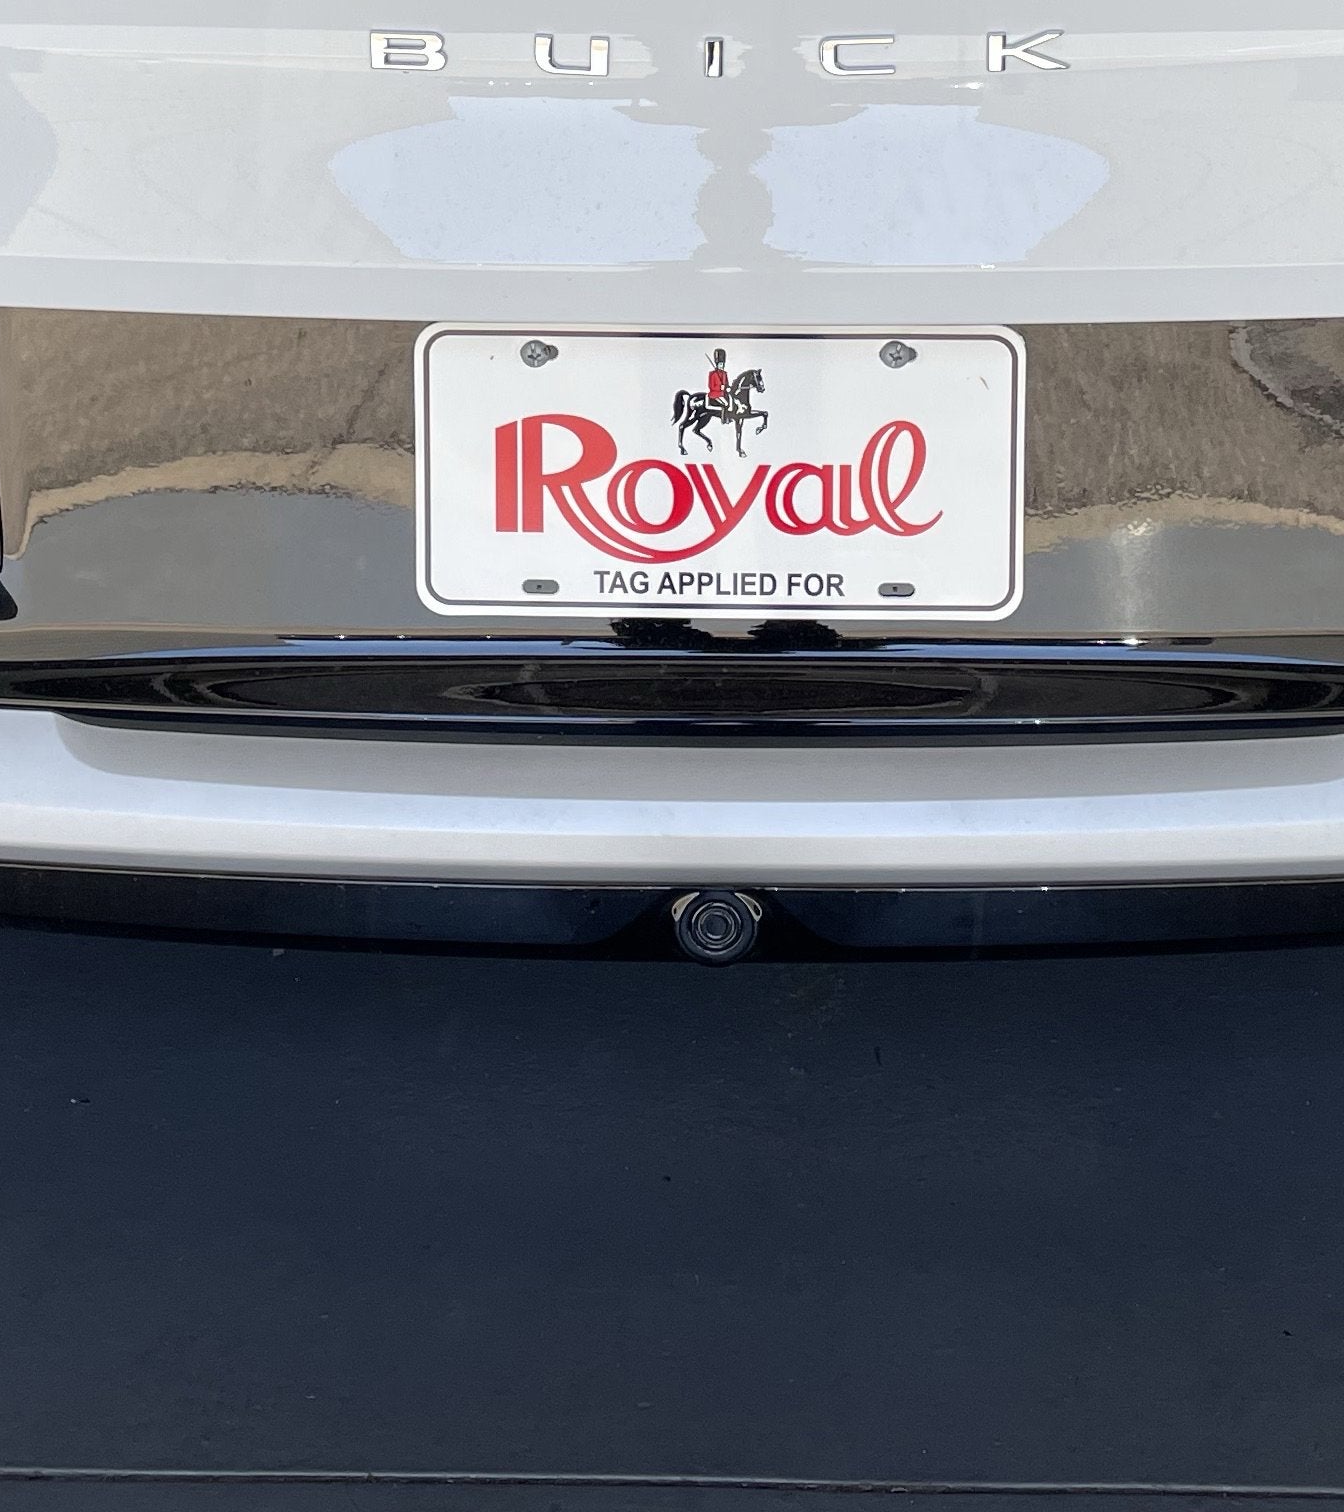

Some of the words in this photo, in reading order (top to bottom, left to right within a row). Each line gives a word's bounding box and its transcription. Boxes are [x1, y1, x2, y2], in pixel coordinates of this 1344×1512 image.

[368, 29, 1071, 78] BUICK
[494, 413, 944, 565] Royal
[594, 570, 650, 595] TAG
[656, 571, 778, 597] APPLIED
[786, 572, 846, 597] FOR
